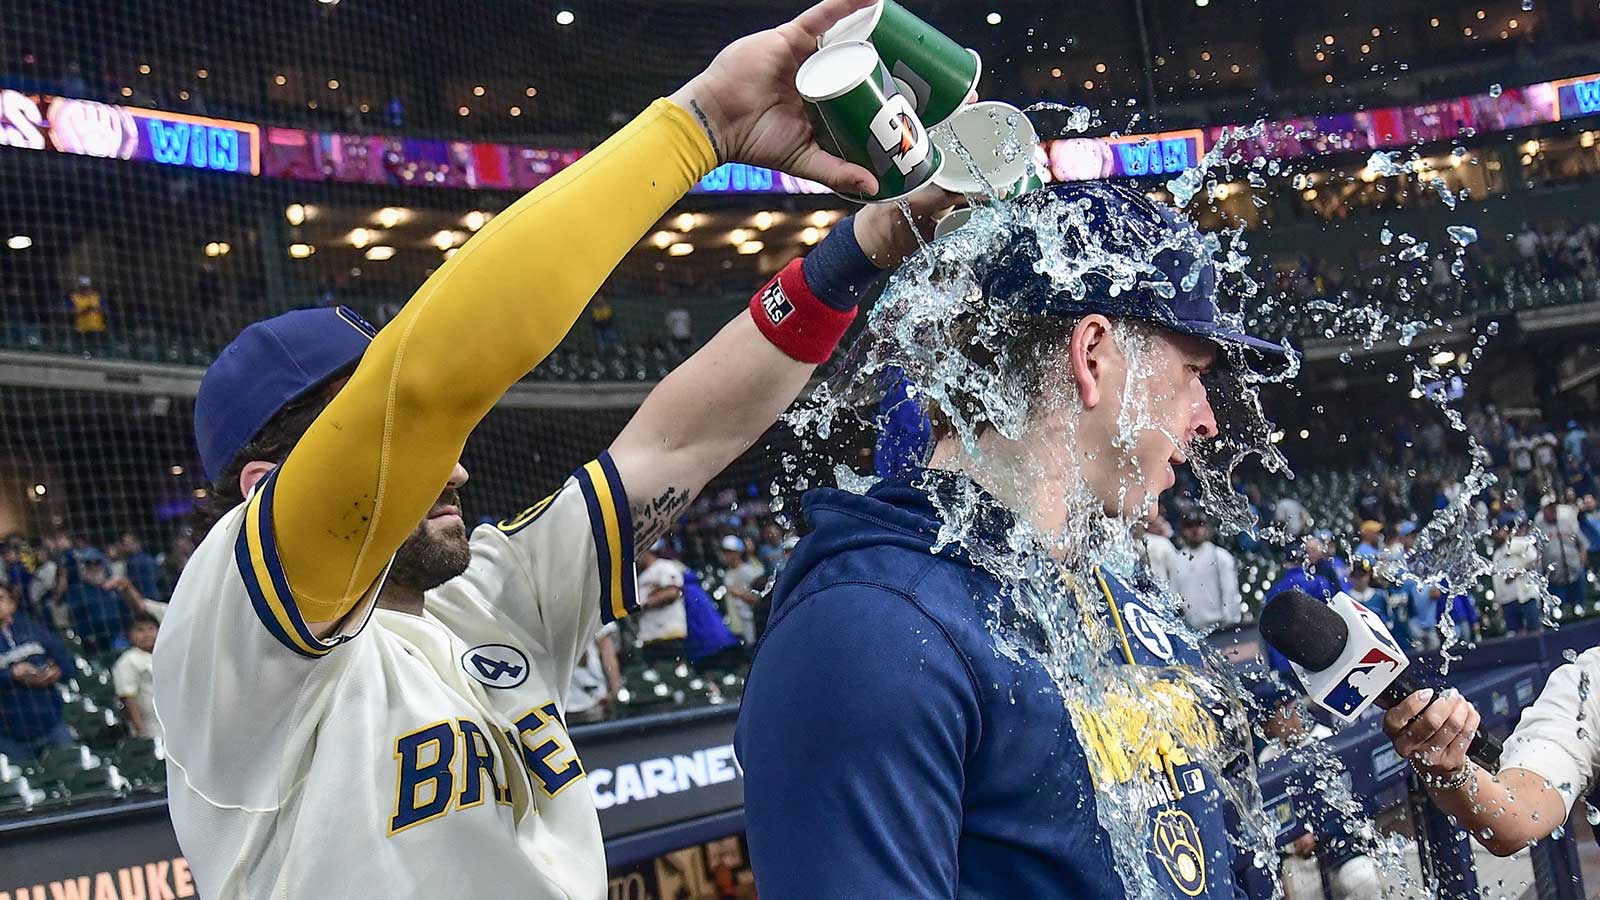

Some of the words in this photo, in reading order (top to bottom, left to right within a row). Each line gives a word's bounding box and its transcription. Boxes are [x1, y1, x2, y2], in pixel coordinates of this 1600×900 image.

[149, 119, 239, 172] WIN
[1119, 138, 1188, 176] WIN
[701, 162, 773, 191] WIN
[470, 653, 523, 681] 4
[587, 744, 743, 810] CARNE
